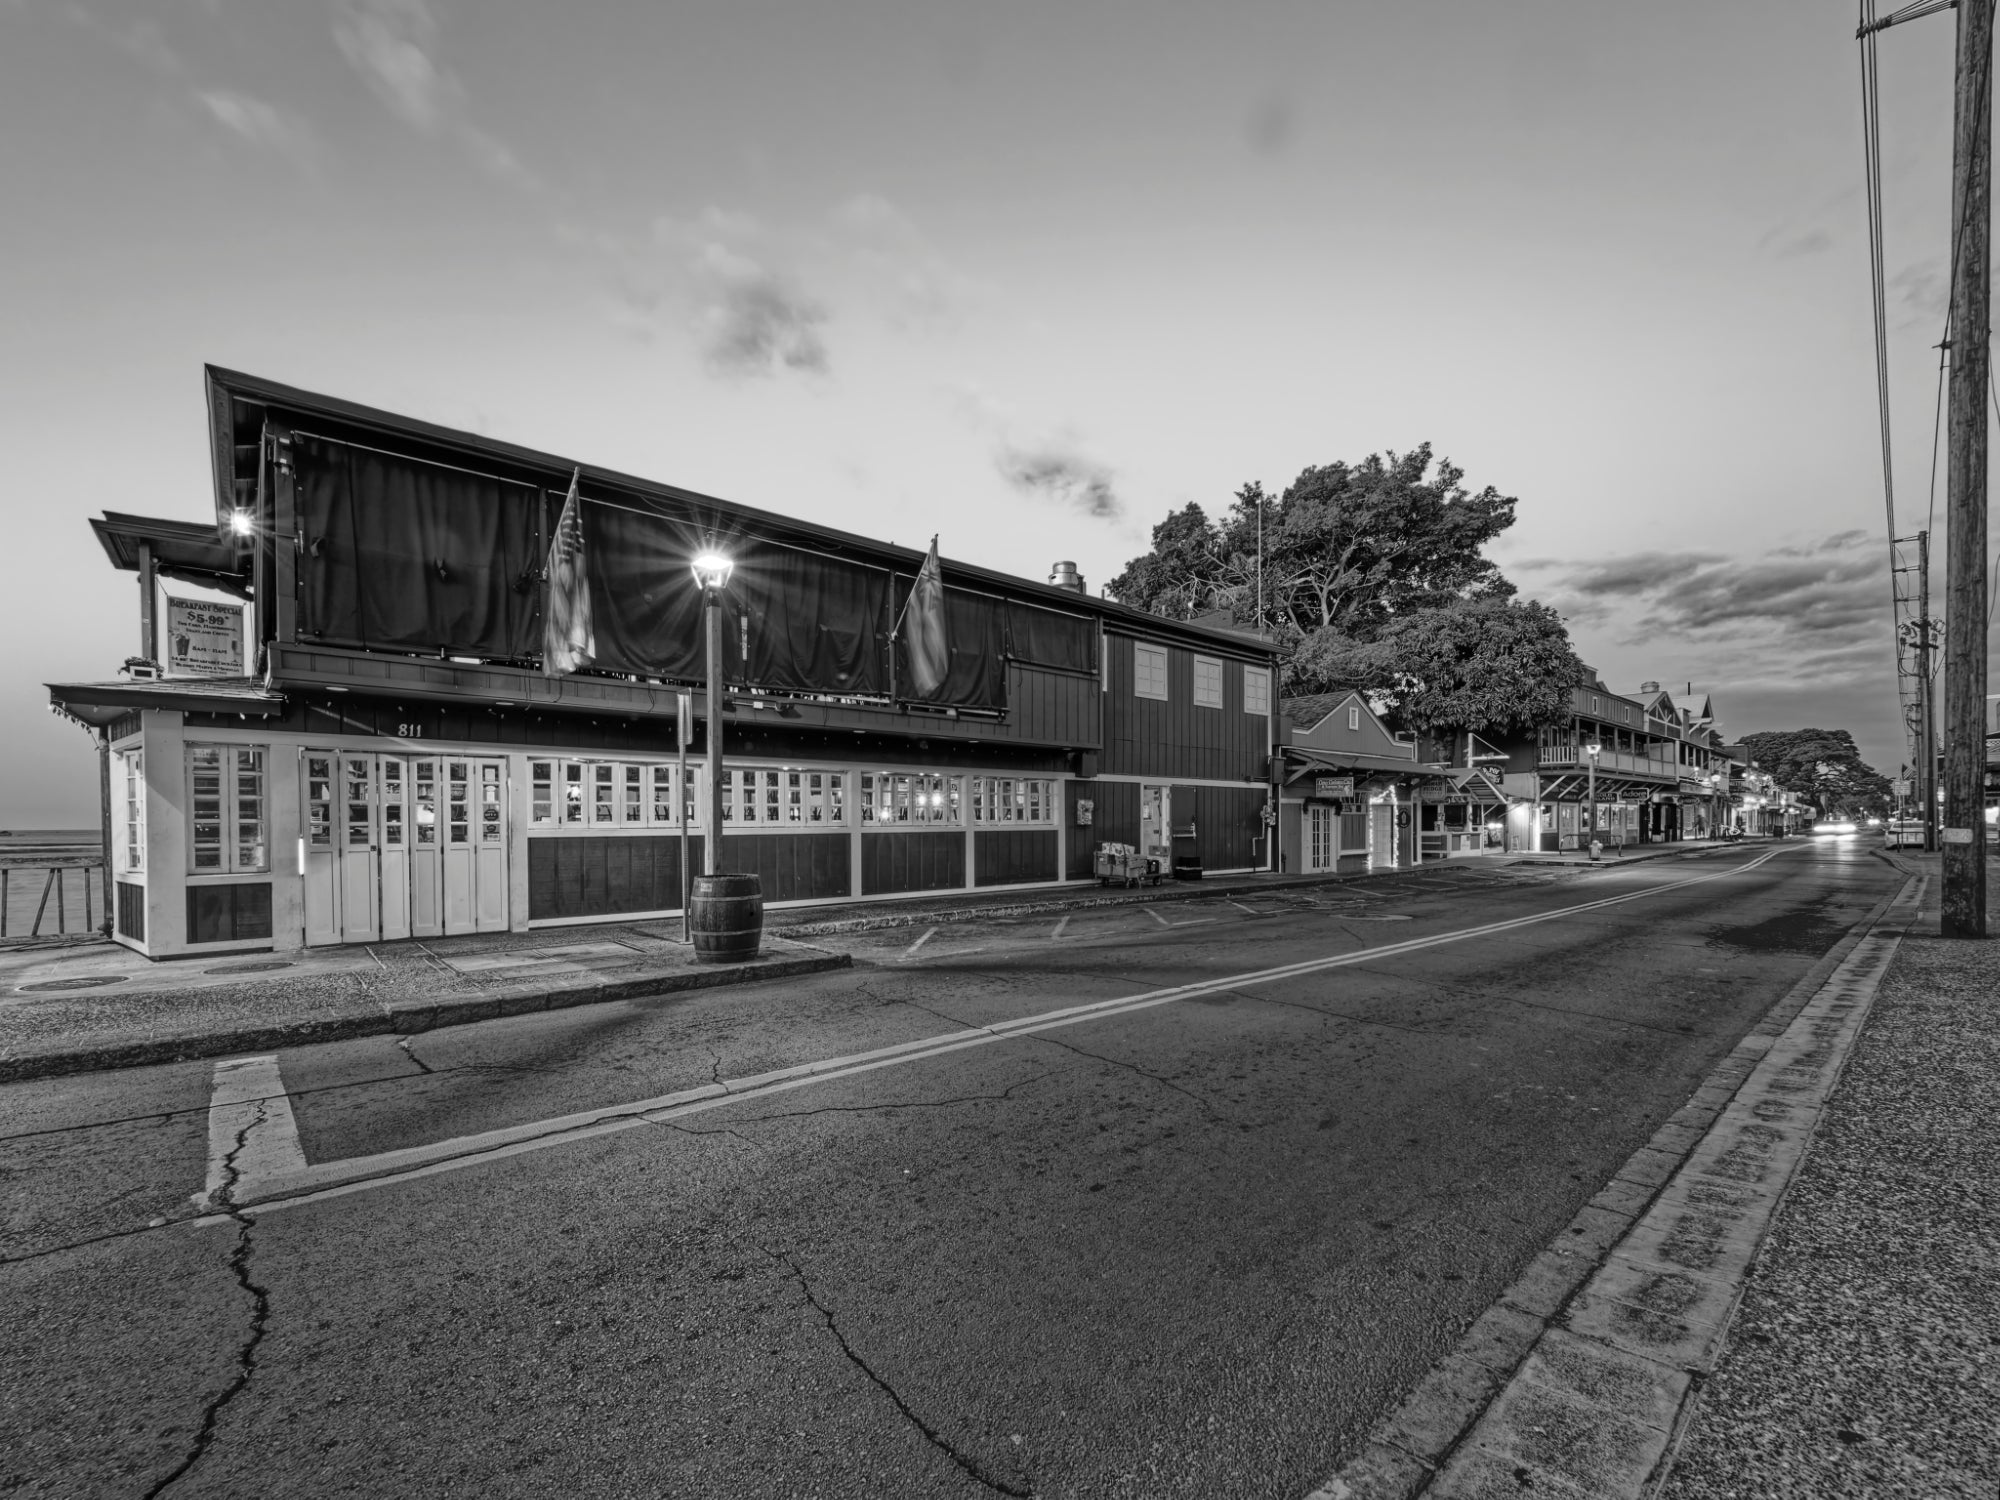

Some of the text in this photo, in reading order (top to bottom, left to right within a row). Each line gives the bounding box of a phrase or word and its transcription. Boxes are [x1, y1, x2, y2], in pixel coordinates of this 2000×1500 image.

[169, 599, 242, 616] BREAKFAST SPECIAL
[398, 723, 421, 738] 811
